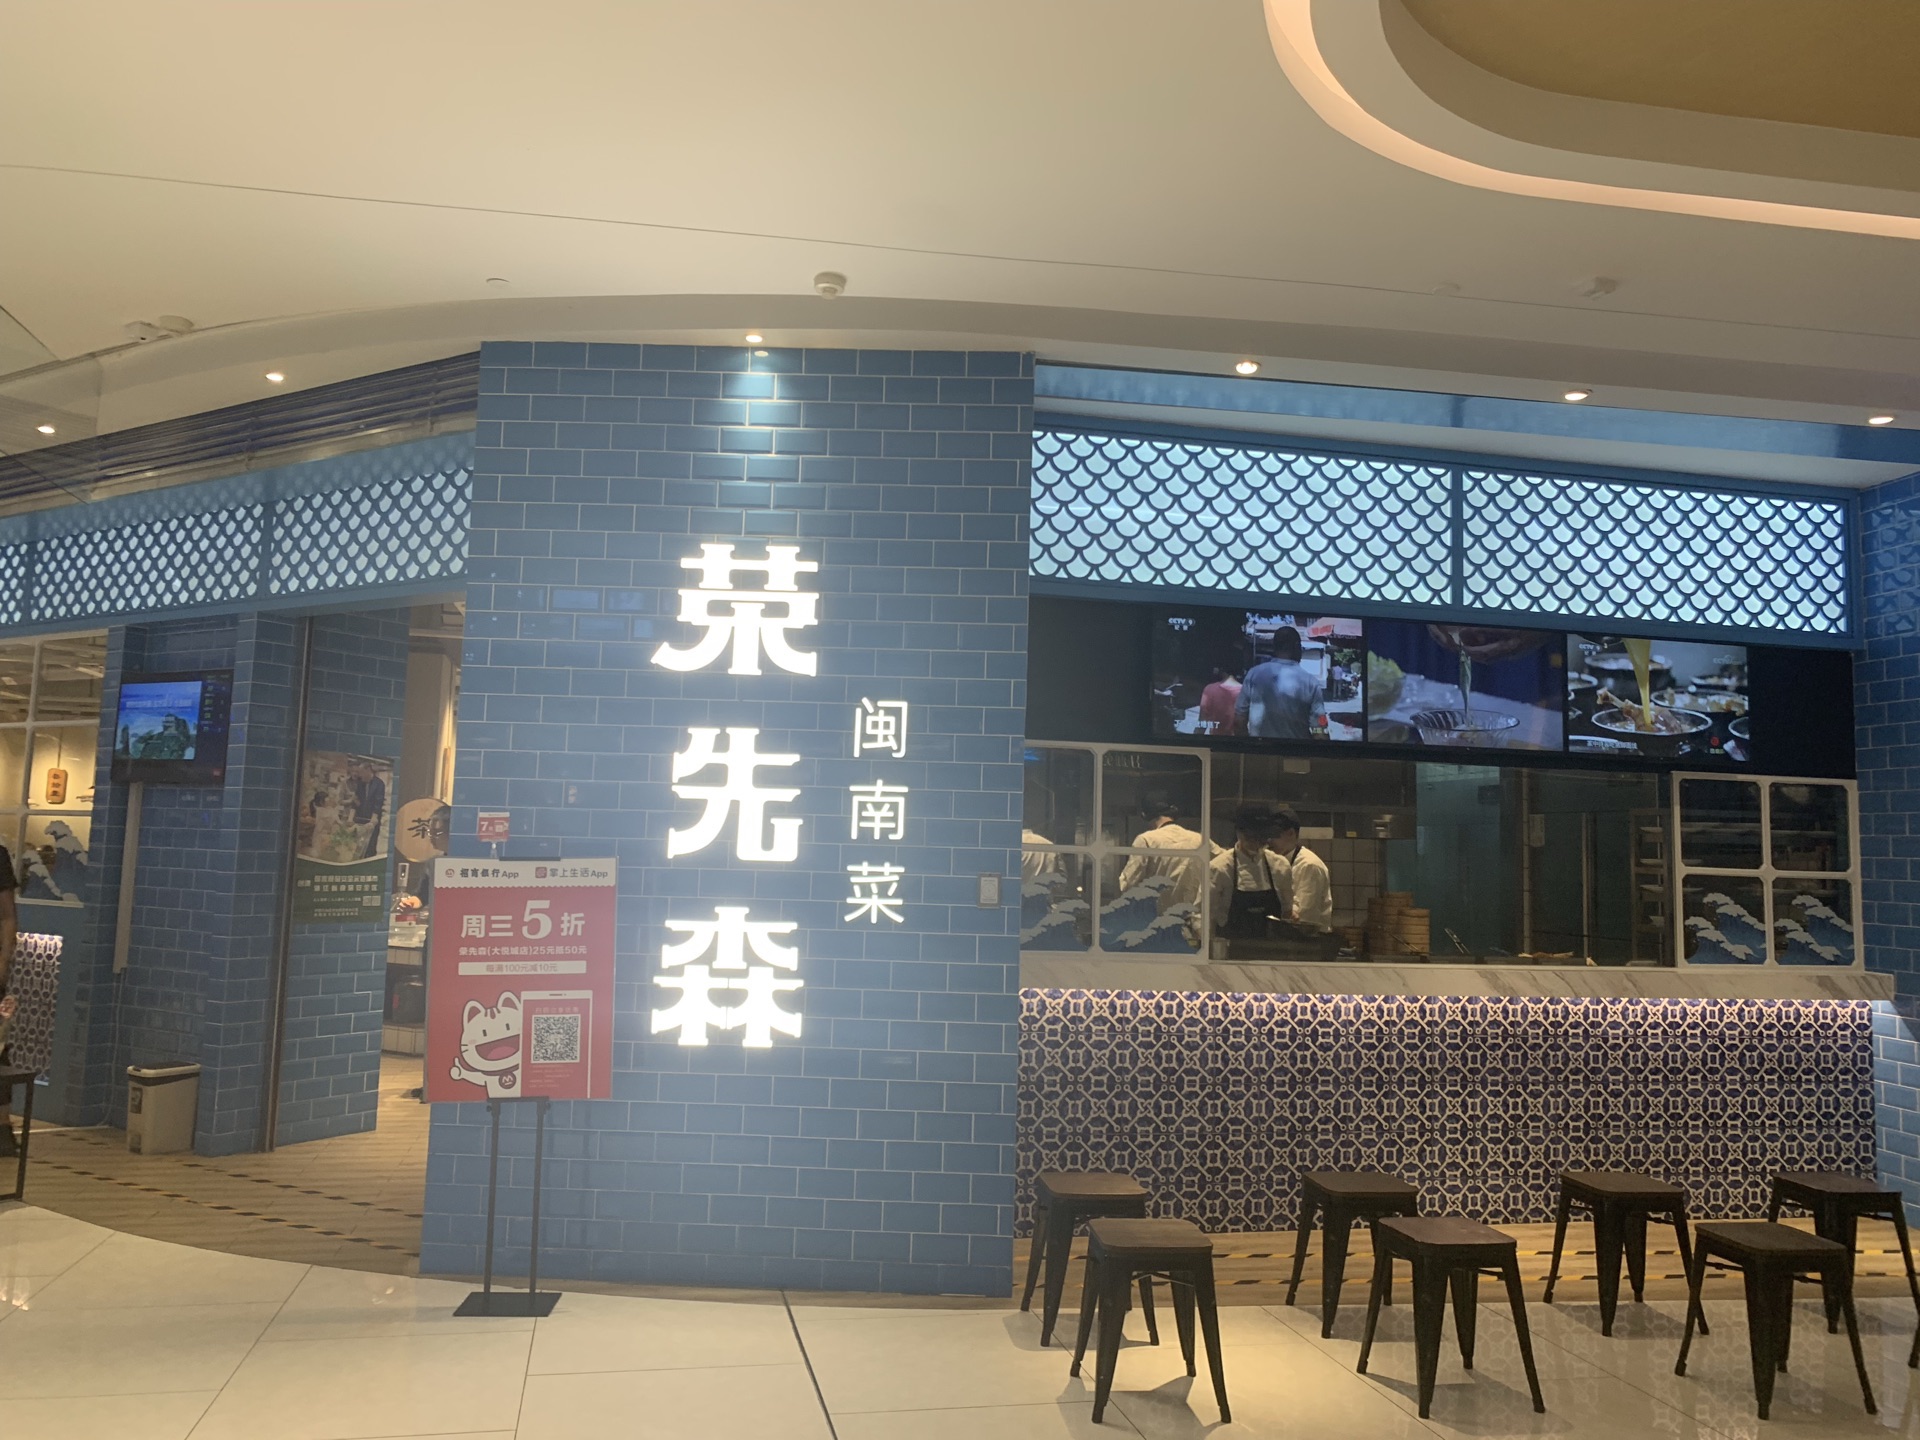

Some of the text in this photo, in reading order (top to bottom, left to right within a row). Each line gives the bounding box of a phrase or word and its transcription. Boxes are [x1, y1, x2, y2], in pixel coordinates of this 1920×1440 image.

[651, 543, 819, 1048] 荣先森
[844, 697, 910, 924] 闽南菜
[486, 963, 558, 973] 每满100元减10元
